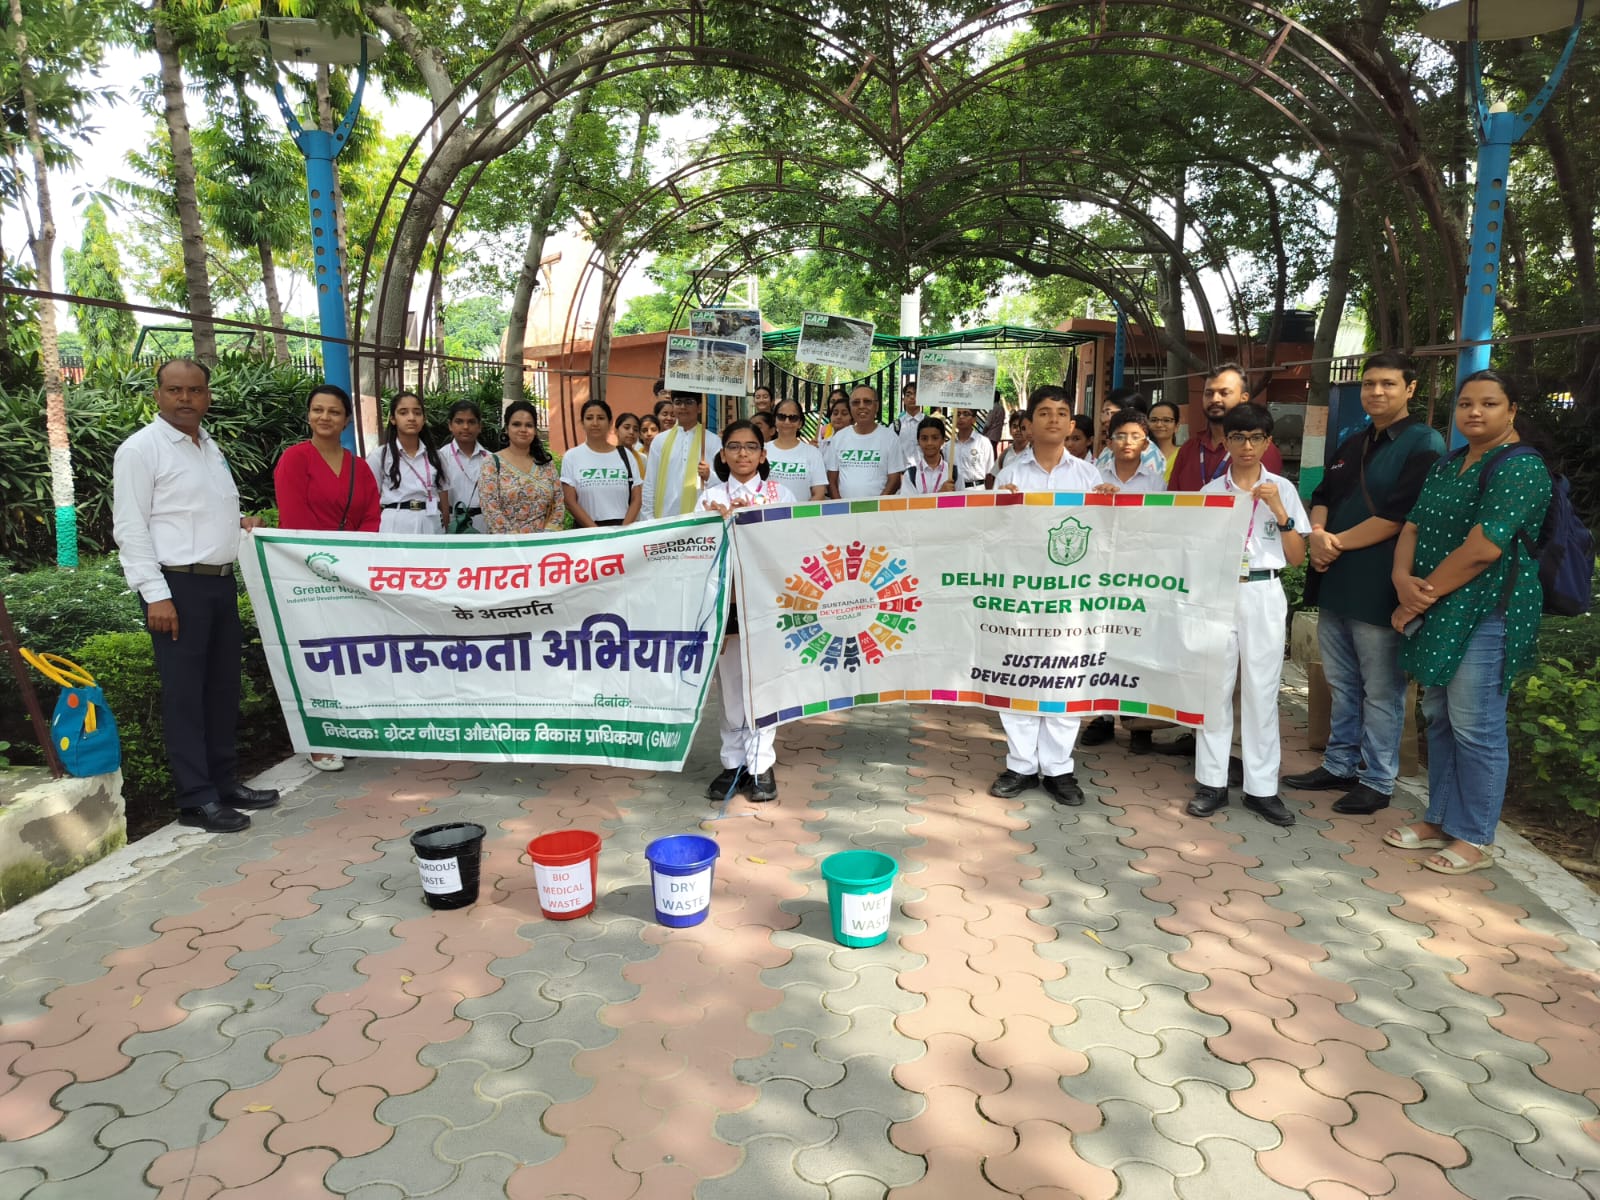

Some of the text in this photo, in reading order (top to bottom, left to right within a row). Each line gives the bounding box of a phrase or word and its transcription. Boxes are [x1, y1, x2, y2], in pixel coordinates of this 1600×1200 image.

[671, 338, 697, 348] CAPP
[840, 450, 881, 461] CAPP
[580, 469, 628, 480] CAPP
[368, 566, 450, 592] स्वच्छ
[457, 564, 532, 591] भारत
[537, 552, 626, 587] मिशन
[941, 572, 1190, 594] DELHI PUBLIC SCHOOL
[293, 585, 336, 596] Greater
[452, 600, 554, 620] के अन्तर्गत
[820, 604, 878, 616] DEVELOPMENT
[822, 597, 874, 609] SUSTAINABLE
[972, 595, 1147, 614] GREATER NOIDA
[836, 612, 862, 621] GOALS
[980, 622, 1142, 638] COMMITTED TO ACHIEVE
[299, 612, 708, 676] जागरूकता अभियान
[1002, 652, 1107, 669] SUSTAINABLE
[970, 668, 1140, 689] DEVELOPMENT GOALS
[384, 723, 416, 742] ग्रेटर
[534, 722, 581, 742] विकास
[584, 724, 644, 746] प्राधिकरण
[552, 873, 570, 882] BIO
[543, 883, 584, 895] MEDICAL
[670, 882, 697, 894] DRY
[548, 898, 581, 908] WASTE
[662, 895, 704, 912] WASTE
[862, 896, 888, 912] WET
